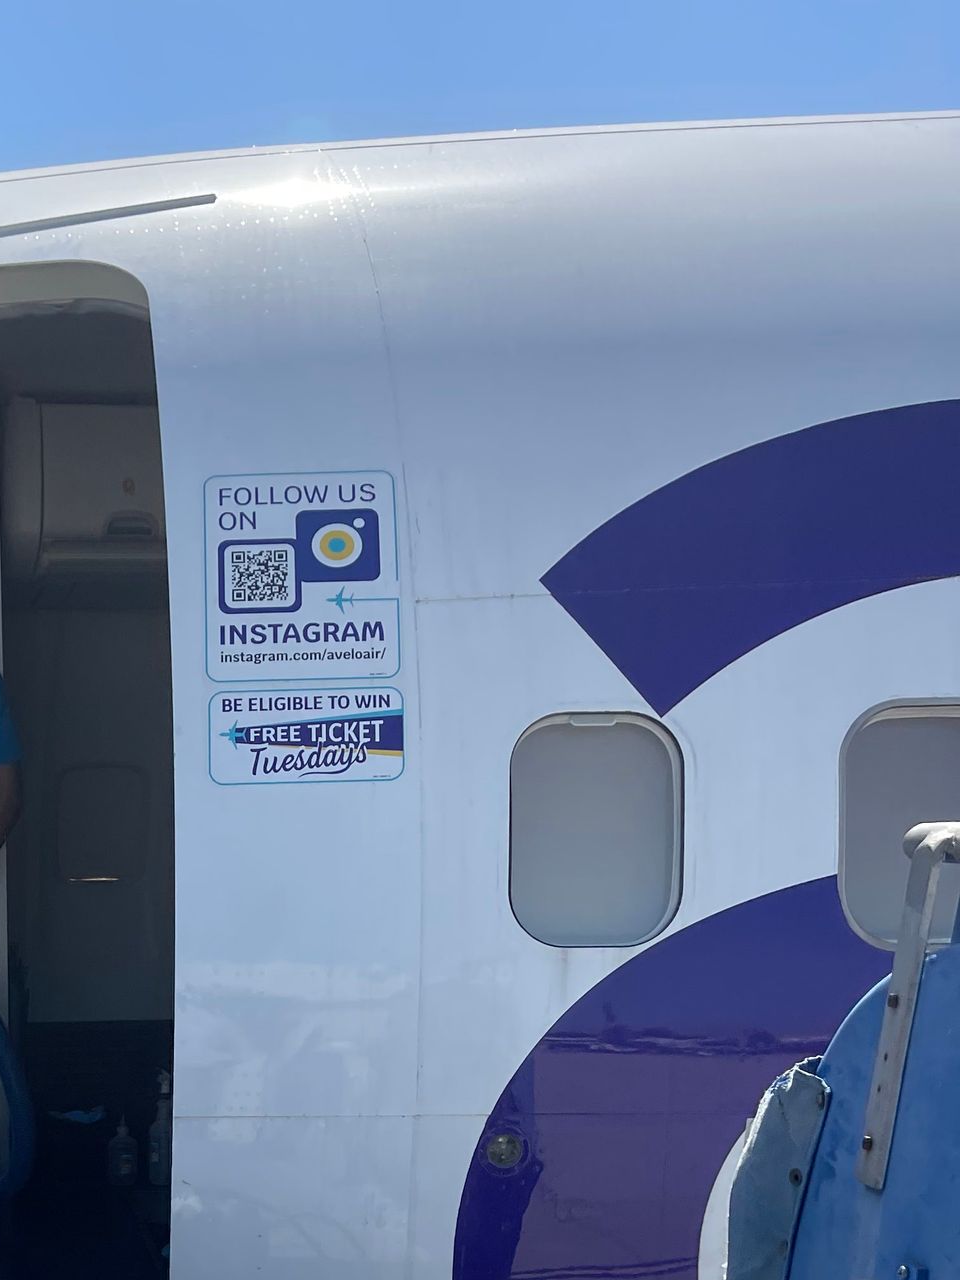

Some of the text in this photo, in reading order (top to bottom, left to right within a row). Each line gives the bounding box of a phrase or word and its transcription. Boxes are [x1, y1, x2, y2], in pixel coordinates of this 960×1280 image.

[218, 483, 376, 506] FOLLOW US
[218, 511, 257, 531] ON
[219, 621, 385, 645] INSTAGRAM
[220, 647, 386, 664] instagram.com/aveloair/
[221, 694, 391, 712] BE ELIGIBLE TO WIN
[249, 720, 384, 742] FREE TICKET
[250, 738, 368, 778] Tuesdays
